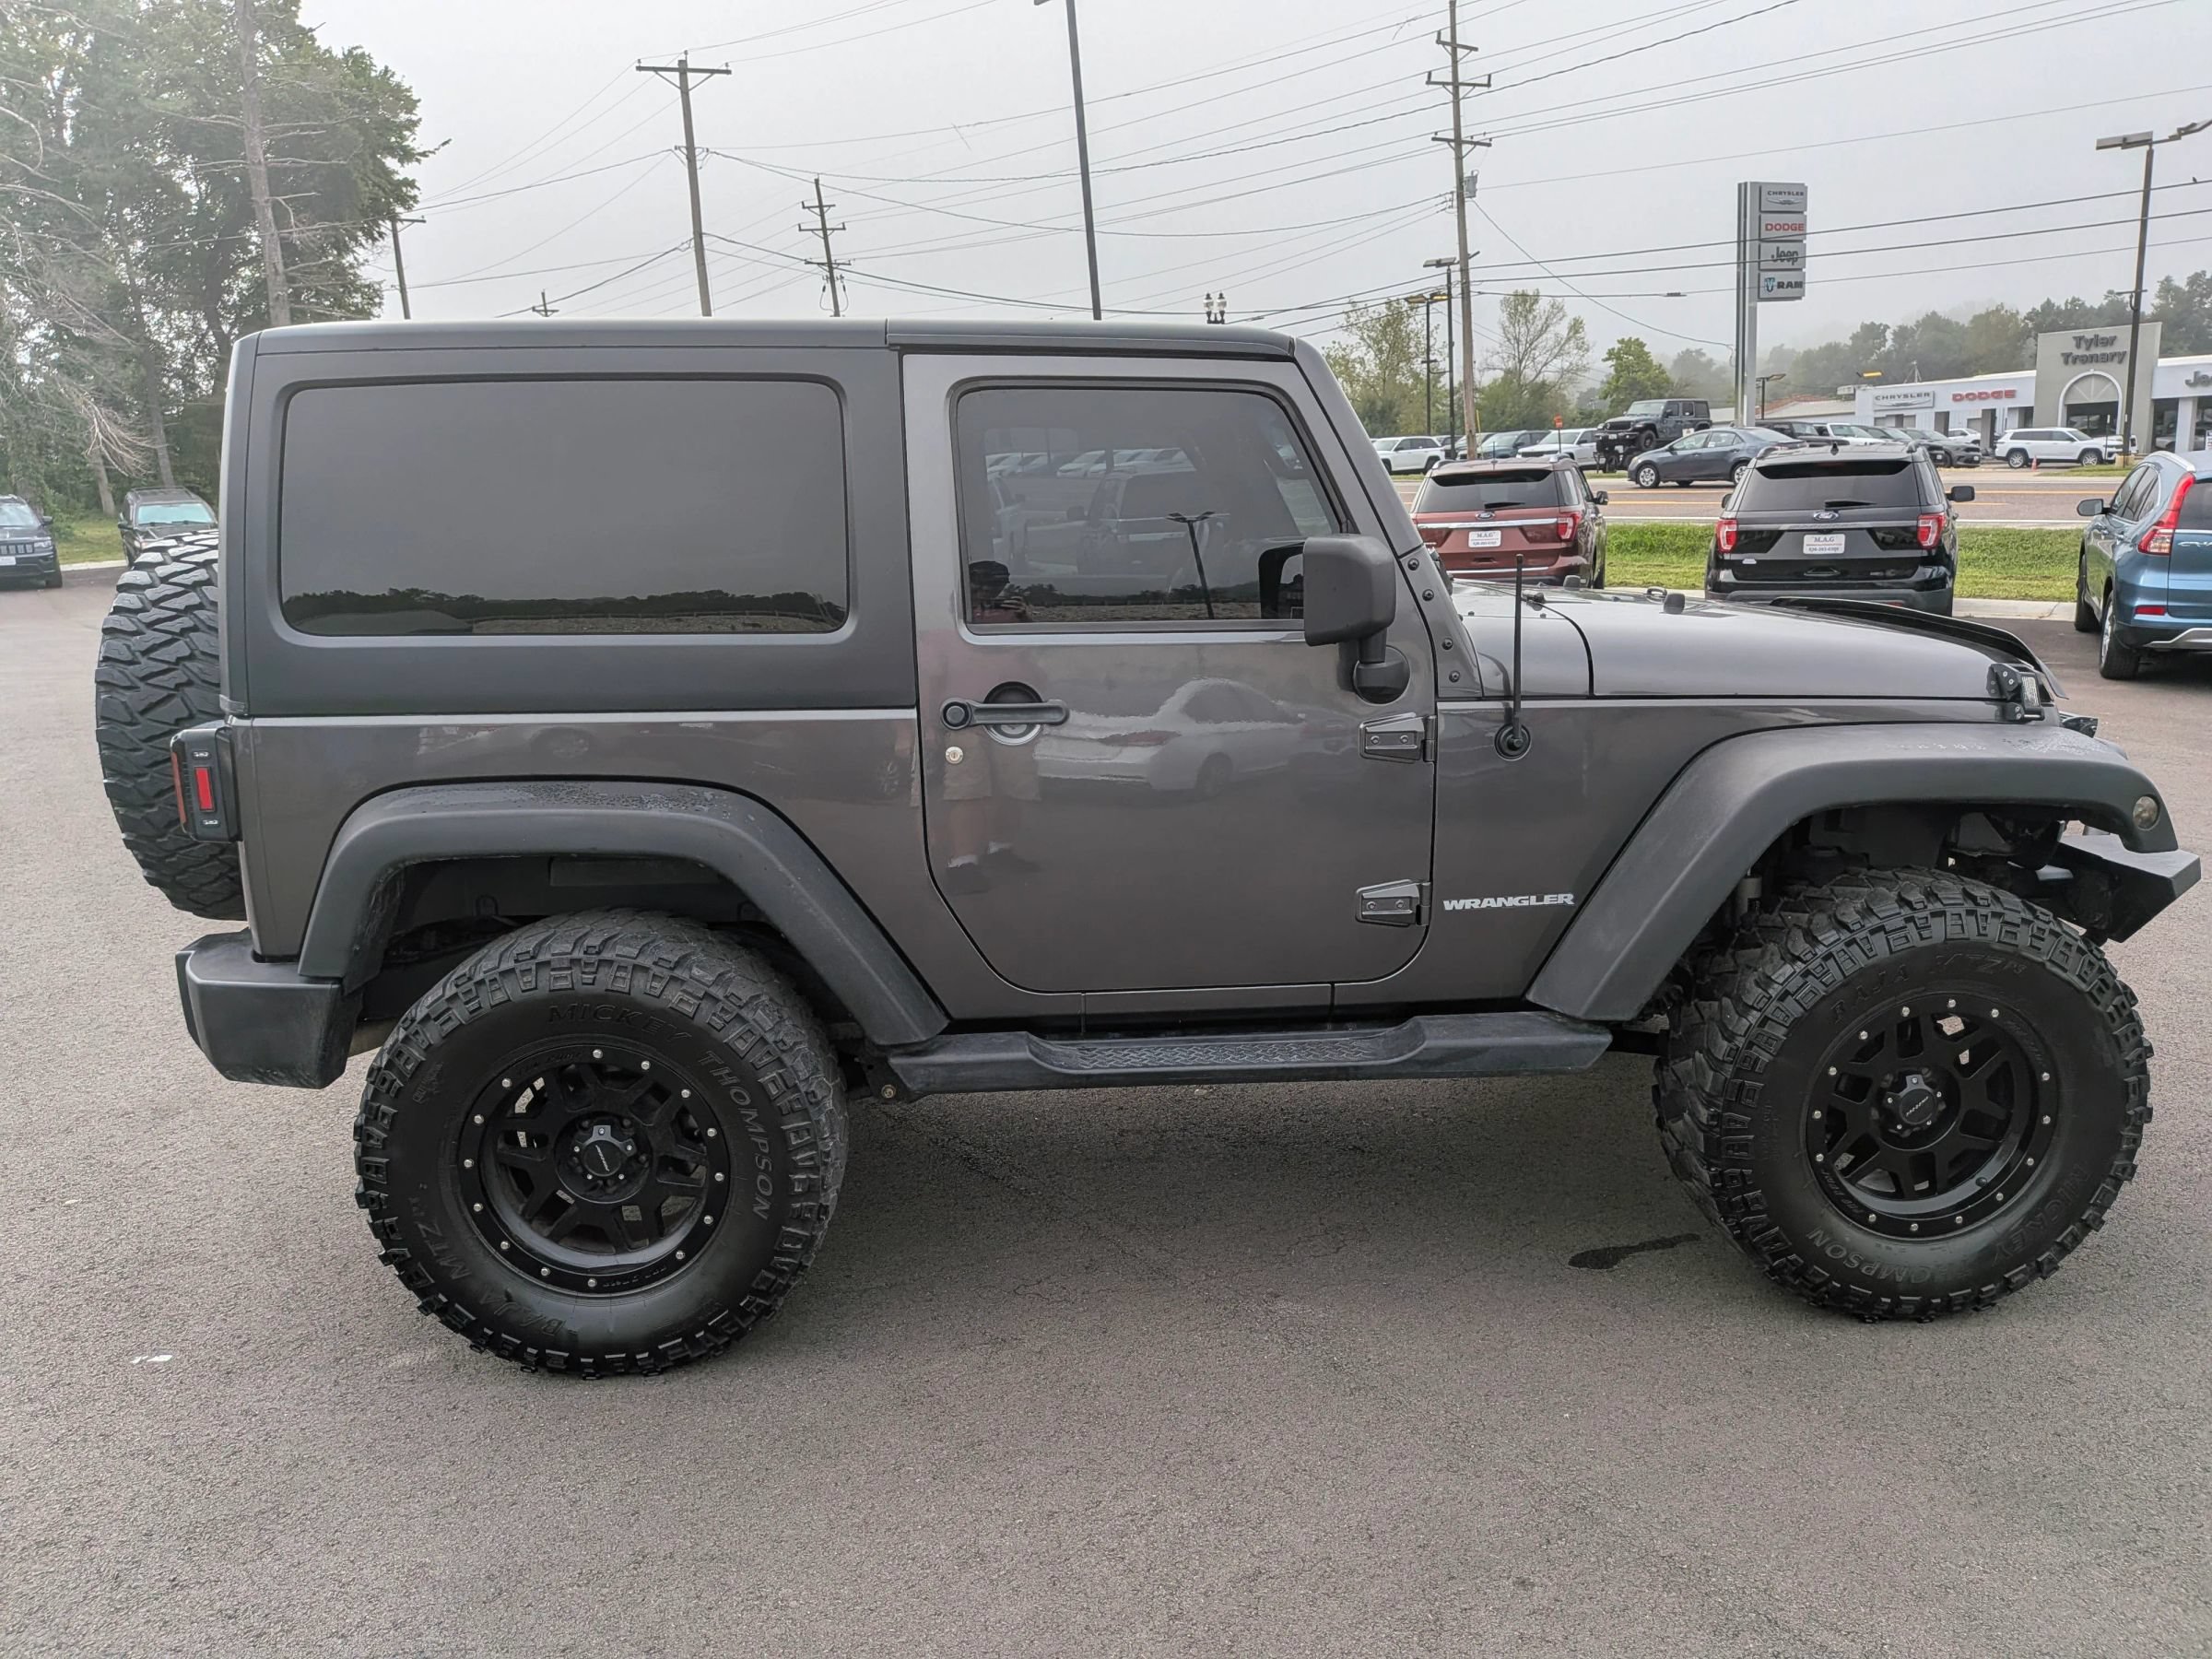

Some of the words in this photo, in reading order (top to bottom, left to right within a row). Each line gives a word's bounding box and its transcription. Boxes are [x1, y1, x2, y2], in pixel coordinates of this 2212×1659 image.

[1765, 223, 1805, 231] DODGE
[1771, 245, 1799, 265] Jeep
[1777, 280, 1804, 289] RAM
[2072, 334, 2117, 351] Tyler
[2060, 351, 2127, 366] Trenary
[1875, 392, 1931, 401] CHRYSLER
[1951, 389, 2018, 402] DODGE
[1443, 893, 1575, 911] WRANGLER
[547, 1003, 692, 1043] MICKEY
[697, 1049, 774, 1221] THOMPSON
[1993, 1163, 2090, 1267] MICKEY
